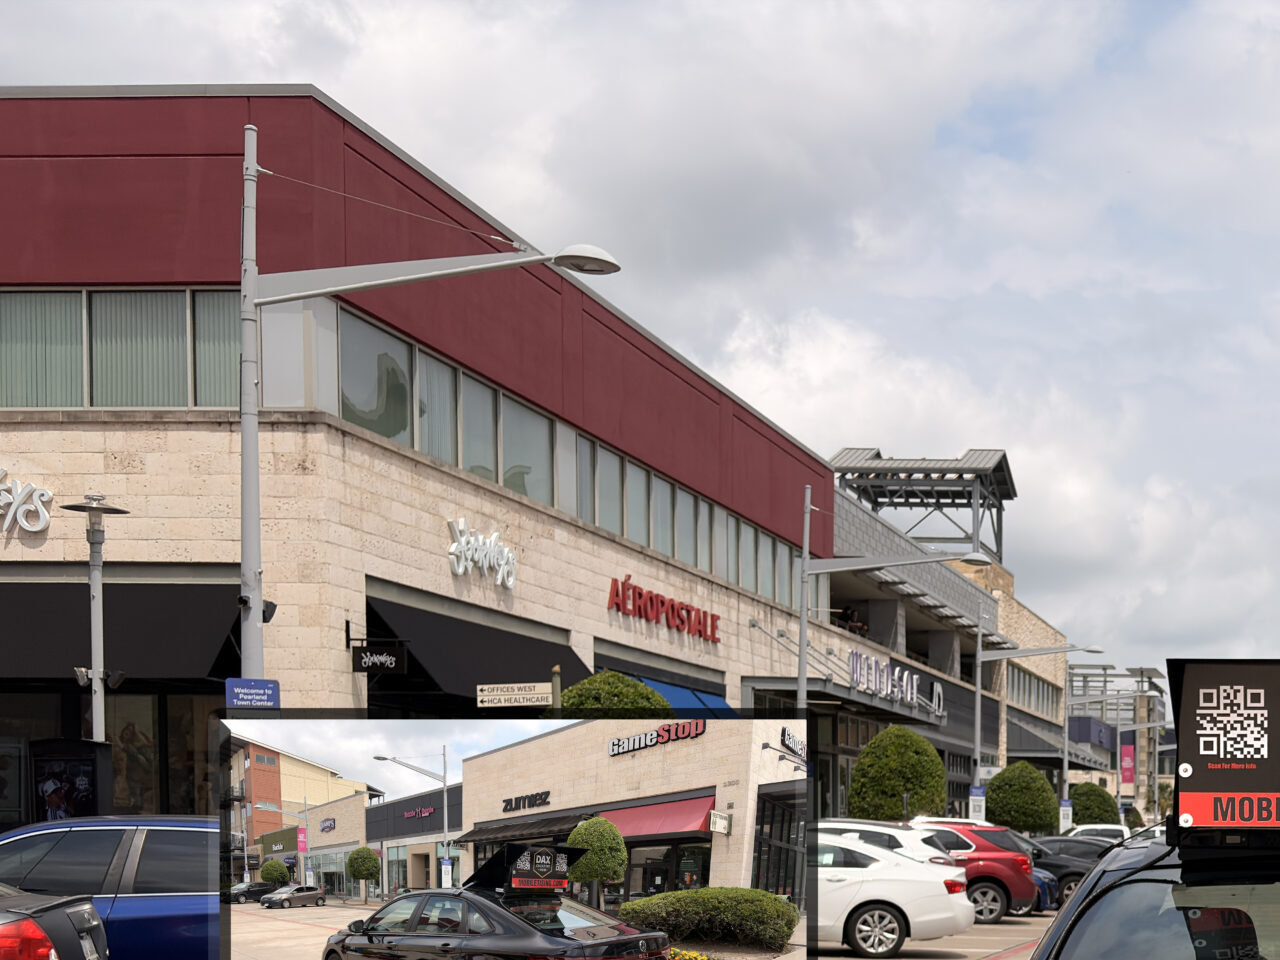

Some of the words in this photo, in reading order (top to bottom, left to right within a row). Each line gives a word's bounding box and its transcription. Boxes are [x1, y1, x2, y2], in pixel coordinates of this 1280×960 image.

[607, 574, 721, 643] AÉROPOSTALE
[234, 687, 264, 695] Welcome
[487, 697, 502, 705] HCA
[504, 695, 550, 704] HEALTHCARE
[608, 720, 705, 757] GameStop
[536, 856, 551, 864] DAX
